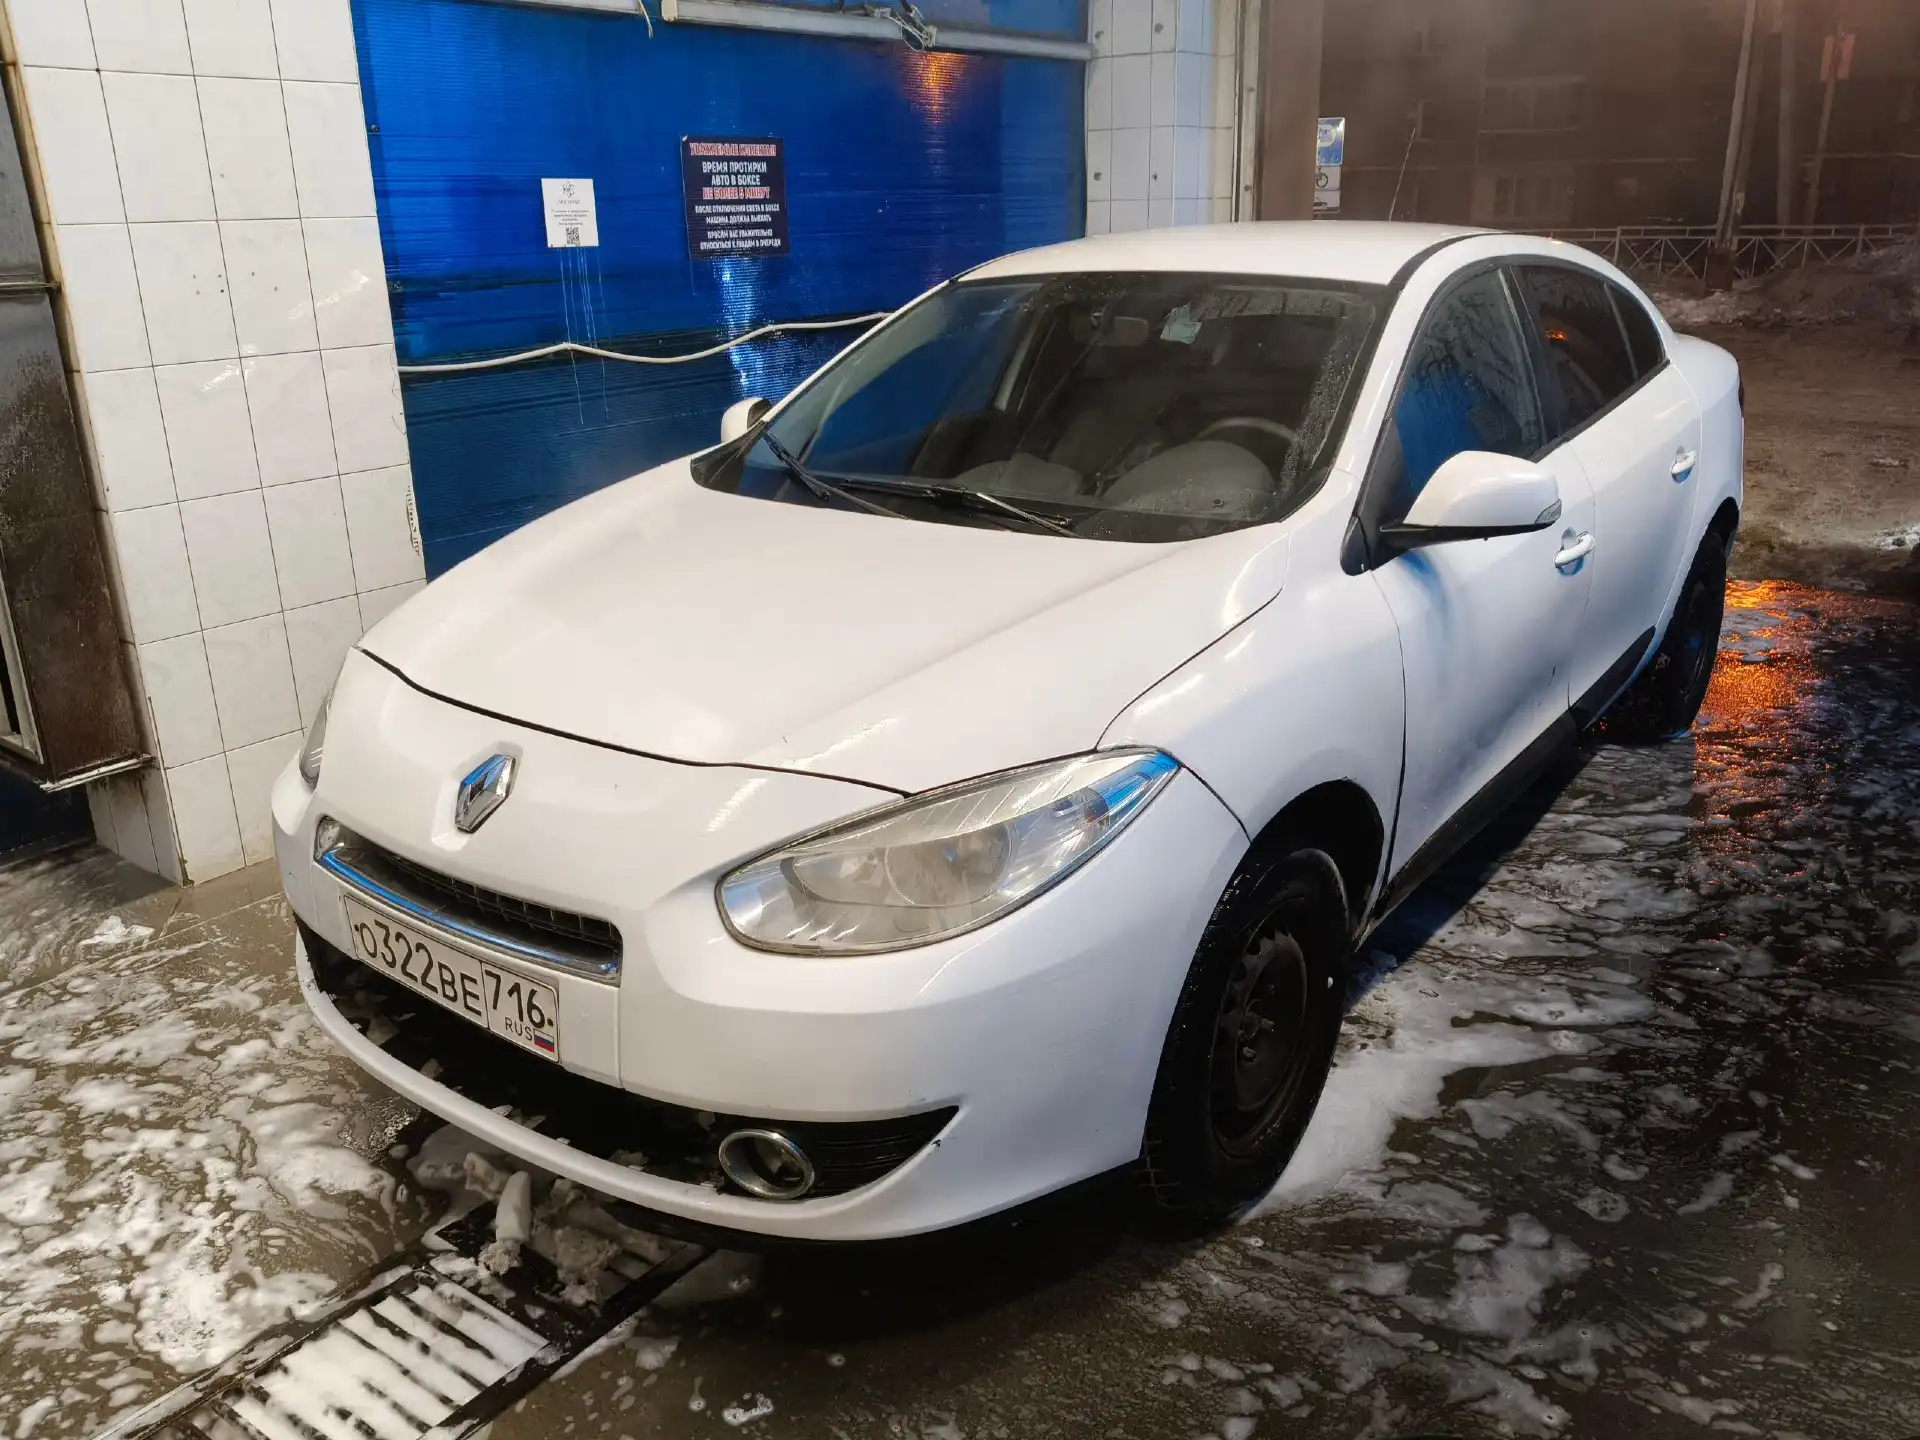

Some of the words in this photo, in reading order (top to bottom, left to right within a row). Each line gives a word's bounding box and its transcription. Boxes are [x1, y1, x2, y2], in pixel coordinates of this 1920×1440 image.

[689, 143, 739, 156] УВАЖАЕМЫЕ
[702, 161, 728, 173] ВРЕМЯ
[729, 161, 767, 173] ПРОТИРКИ
[711, 174, 729, 186] АВТО
[731, 174, 736, 186] В
[737, 174, 761, 186] БОКСЕ
[702, 187, 714, 200] НЕ
[714, 187, 739, 200] БОЛЕЕ
[739, 187, 745, 199] 5
[745, 187, 770, 199] МИНУТ
[695, 205, 712, 213] ПОСЛЕ
[713, 204, 746, 213] ОТКЛЮЧЕНИЯ
[746, 204, 761, 212] СВЕТА
[761, 204, 765, 212] В
[765, 204, 780, 212] БОКСЕ
[706, 216, 729, 224] МАШИНА
[729, 215, 750, 224] ДОЛЖНА
[750, 214, 772, 222] ВЫЕХАТЬ
[707, 230, 729, 239] ПРОСИМ
[729, 230, 738, 238] ВАС
[739, 229, 773, 238] УВАЖИТЕЛЬНО
[700, 241, 731, 250] ОТНОСИТЬСЯ
[760, 238, 781, 247] ОЧЕРЕДИ
[484, 969, 546, 1029] 716
[504, 1016, 533, 1041] RUS
